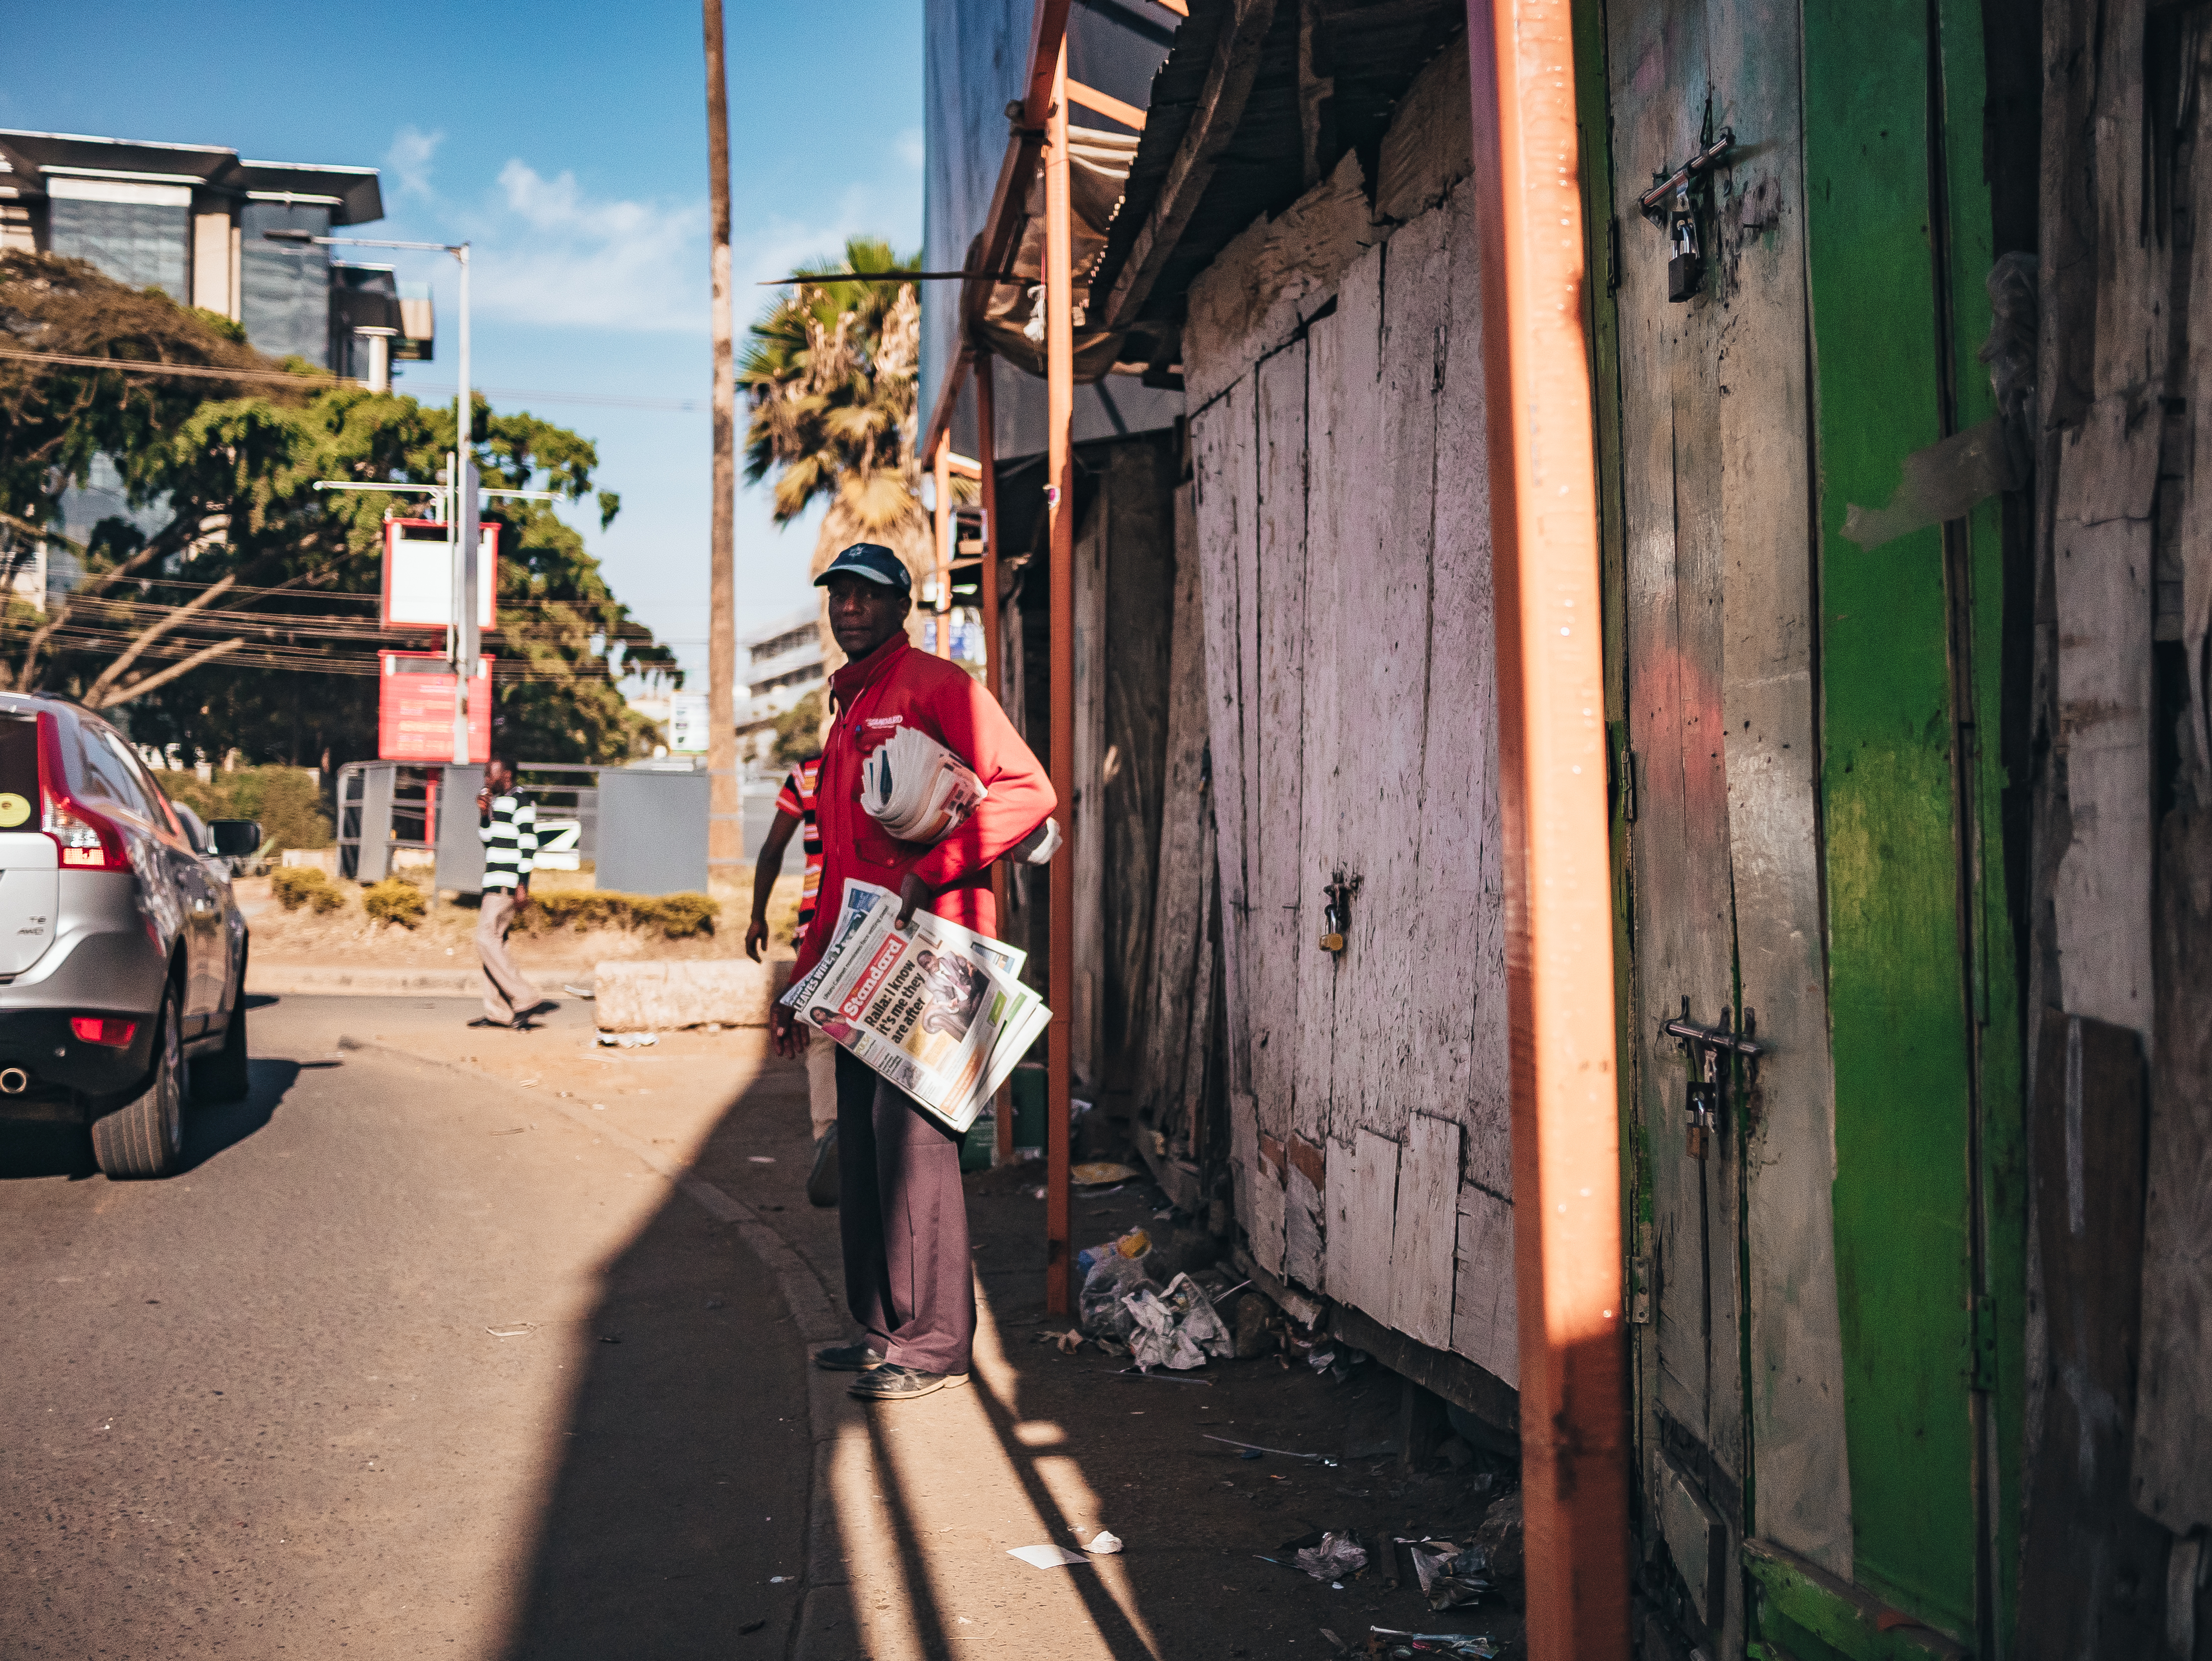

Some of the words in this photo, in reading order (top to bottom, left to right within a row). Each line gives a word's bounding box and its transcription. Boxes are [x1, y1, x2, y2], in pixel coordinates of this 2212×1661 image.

[794, 979, 818, 1011] LEAVES
[814, 957, 835, 980] WIFE,
[844, 938, 902, 1016] Standard
[884, 988, 895, 996] I
[888, 960, 915, 991] know
[864, 994, 892, 1027] Raila:
[876, 1016, 896, 1036] it's
[891, 998, 908, 1018] me
[901, 973, 925, 999] they
[891, 1024, 909, 1044] are
[904, 997, 925, 1026] after
